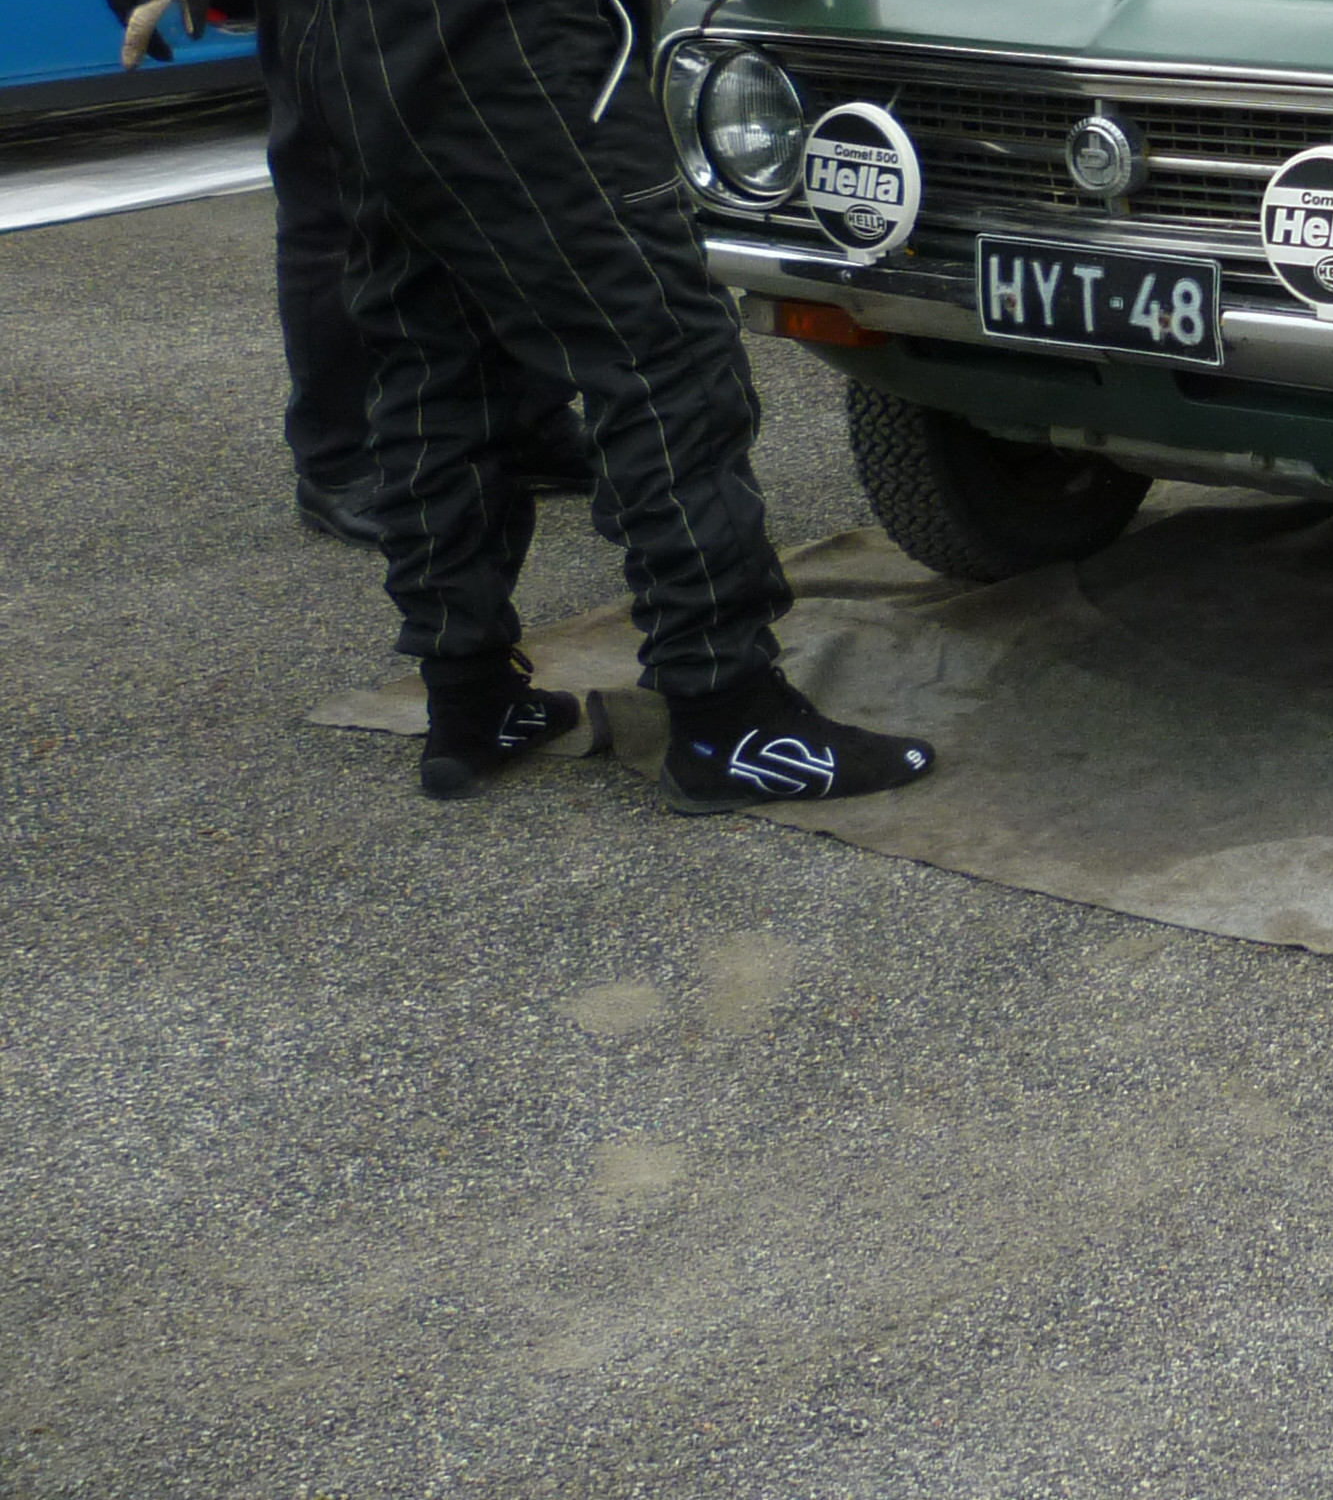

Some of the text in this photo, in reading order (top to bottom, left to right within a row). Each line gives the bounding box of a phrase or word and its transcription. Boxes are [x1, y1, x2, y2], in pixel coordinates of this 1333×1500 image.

[834, 144, 898, 164] Comet 500
[810, 157, 900, 203] Hella
[850, 212, 885, 232] HELLA
[989, 254, 1204, 345] HYT-48
